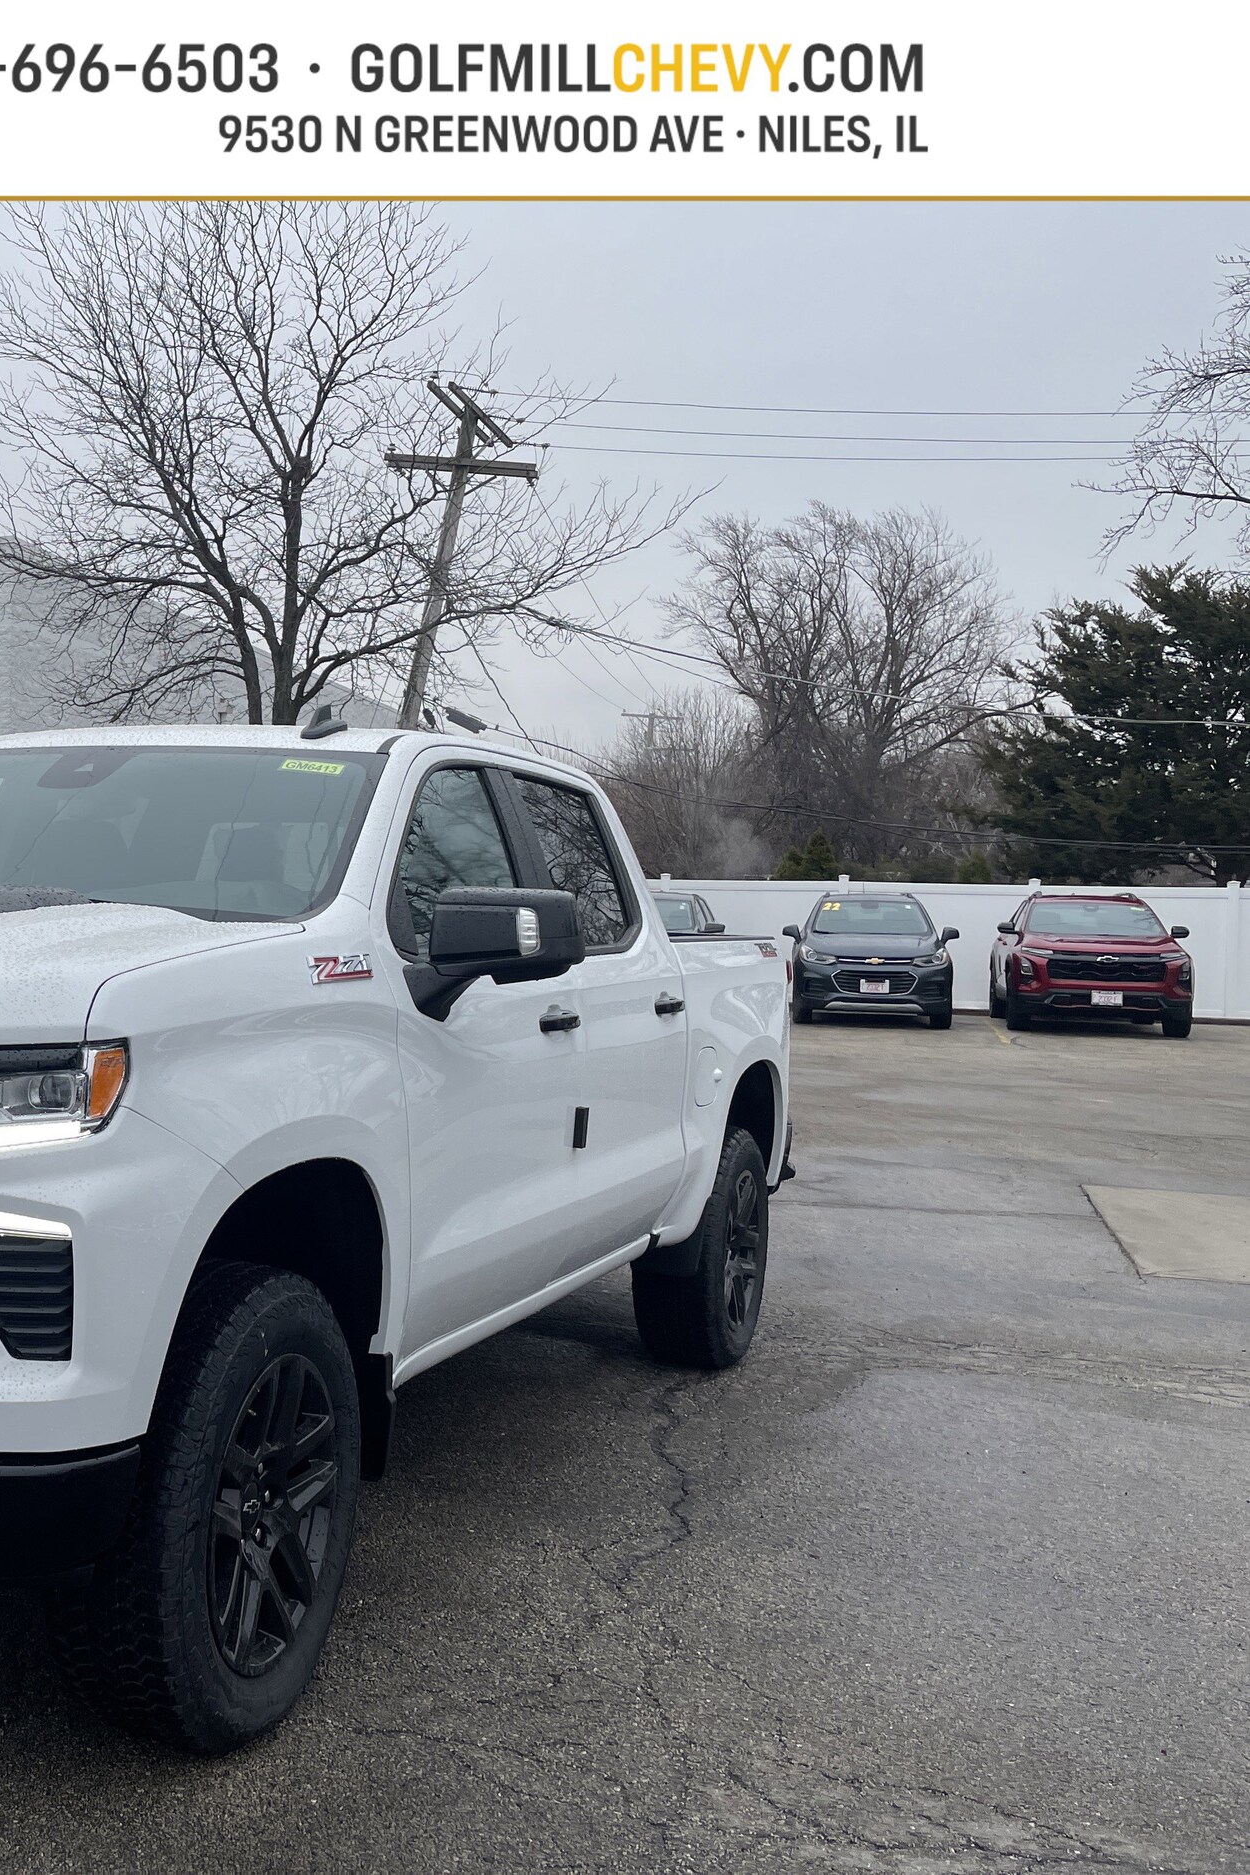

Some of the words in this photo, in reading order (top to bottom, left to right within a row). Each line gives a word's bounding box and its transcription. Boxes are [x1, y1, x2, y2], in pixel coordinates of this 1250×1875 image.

[285, 761, 338, 773] GM6413
[822, 902, 841, 911] 22
[306, 953, 374, 985] Z71
